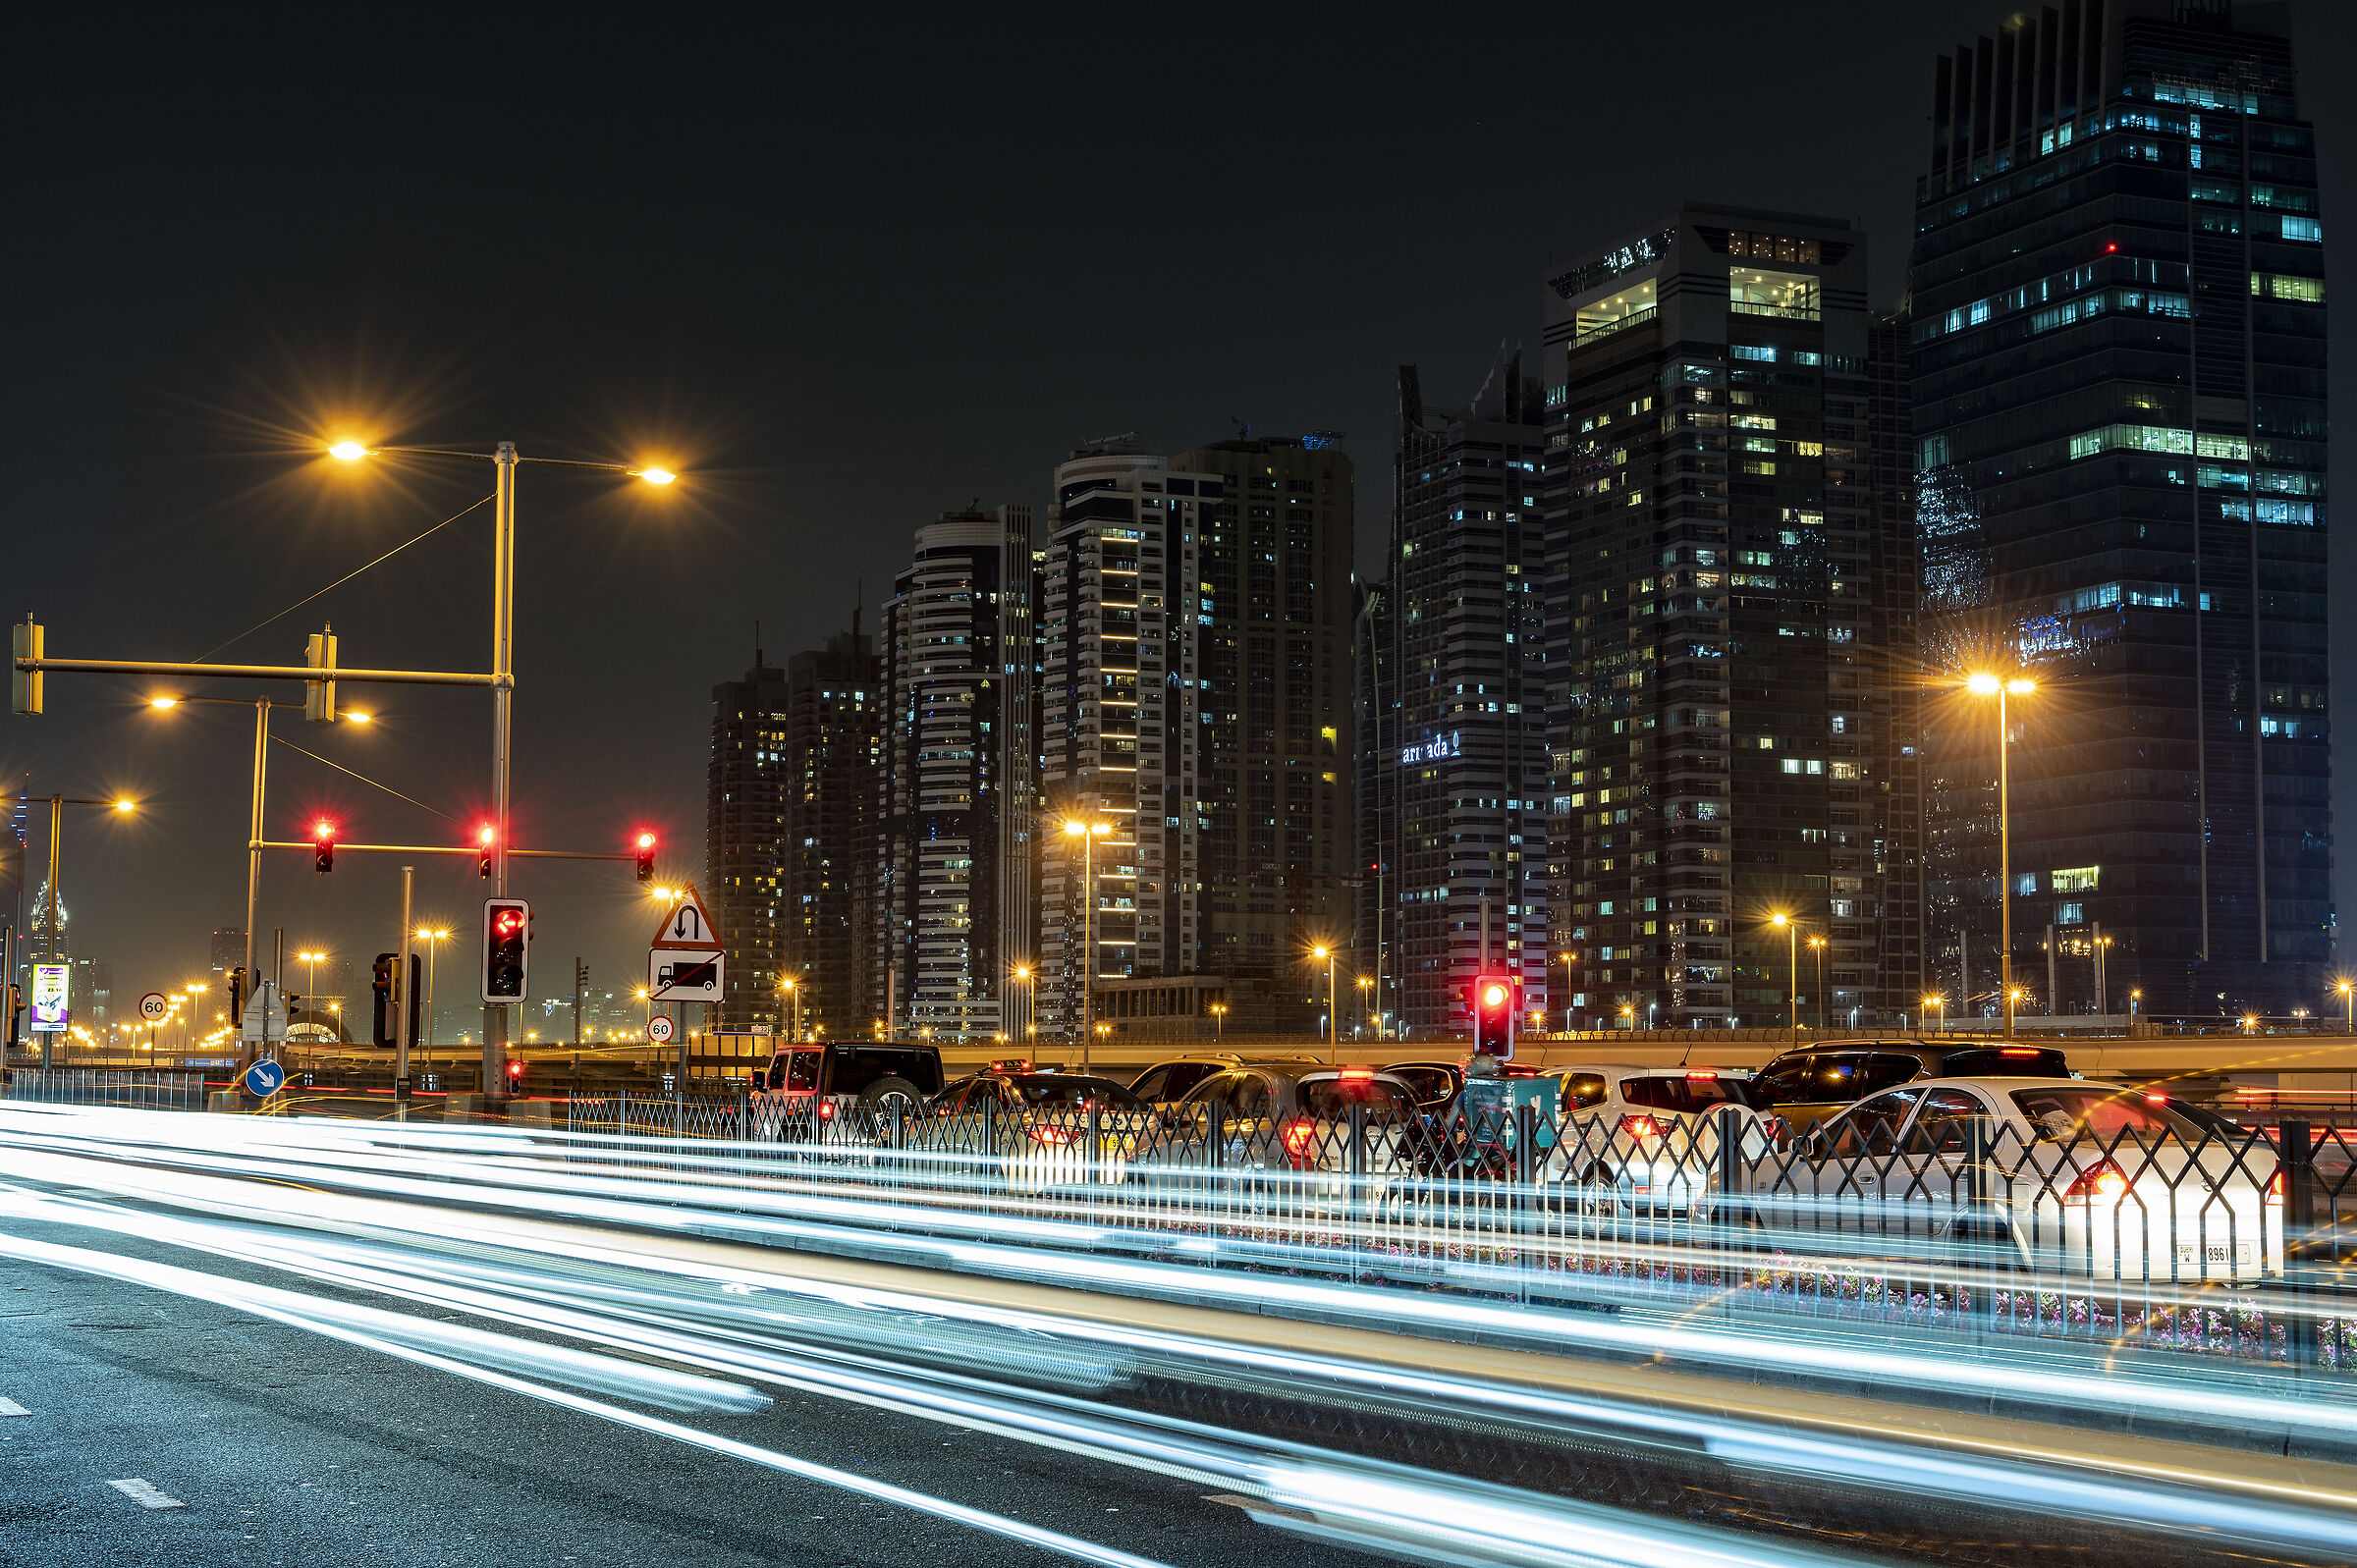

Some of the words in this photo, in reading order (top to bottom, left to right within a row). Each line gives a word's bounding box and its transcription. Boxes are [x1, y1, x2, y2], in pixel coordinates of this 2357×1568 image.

[144, 1001, 163, 1013] 60
[653, 1024, 669, 1035] 60
[2208, 1247, 2229, 1262] 8961
